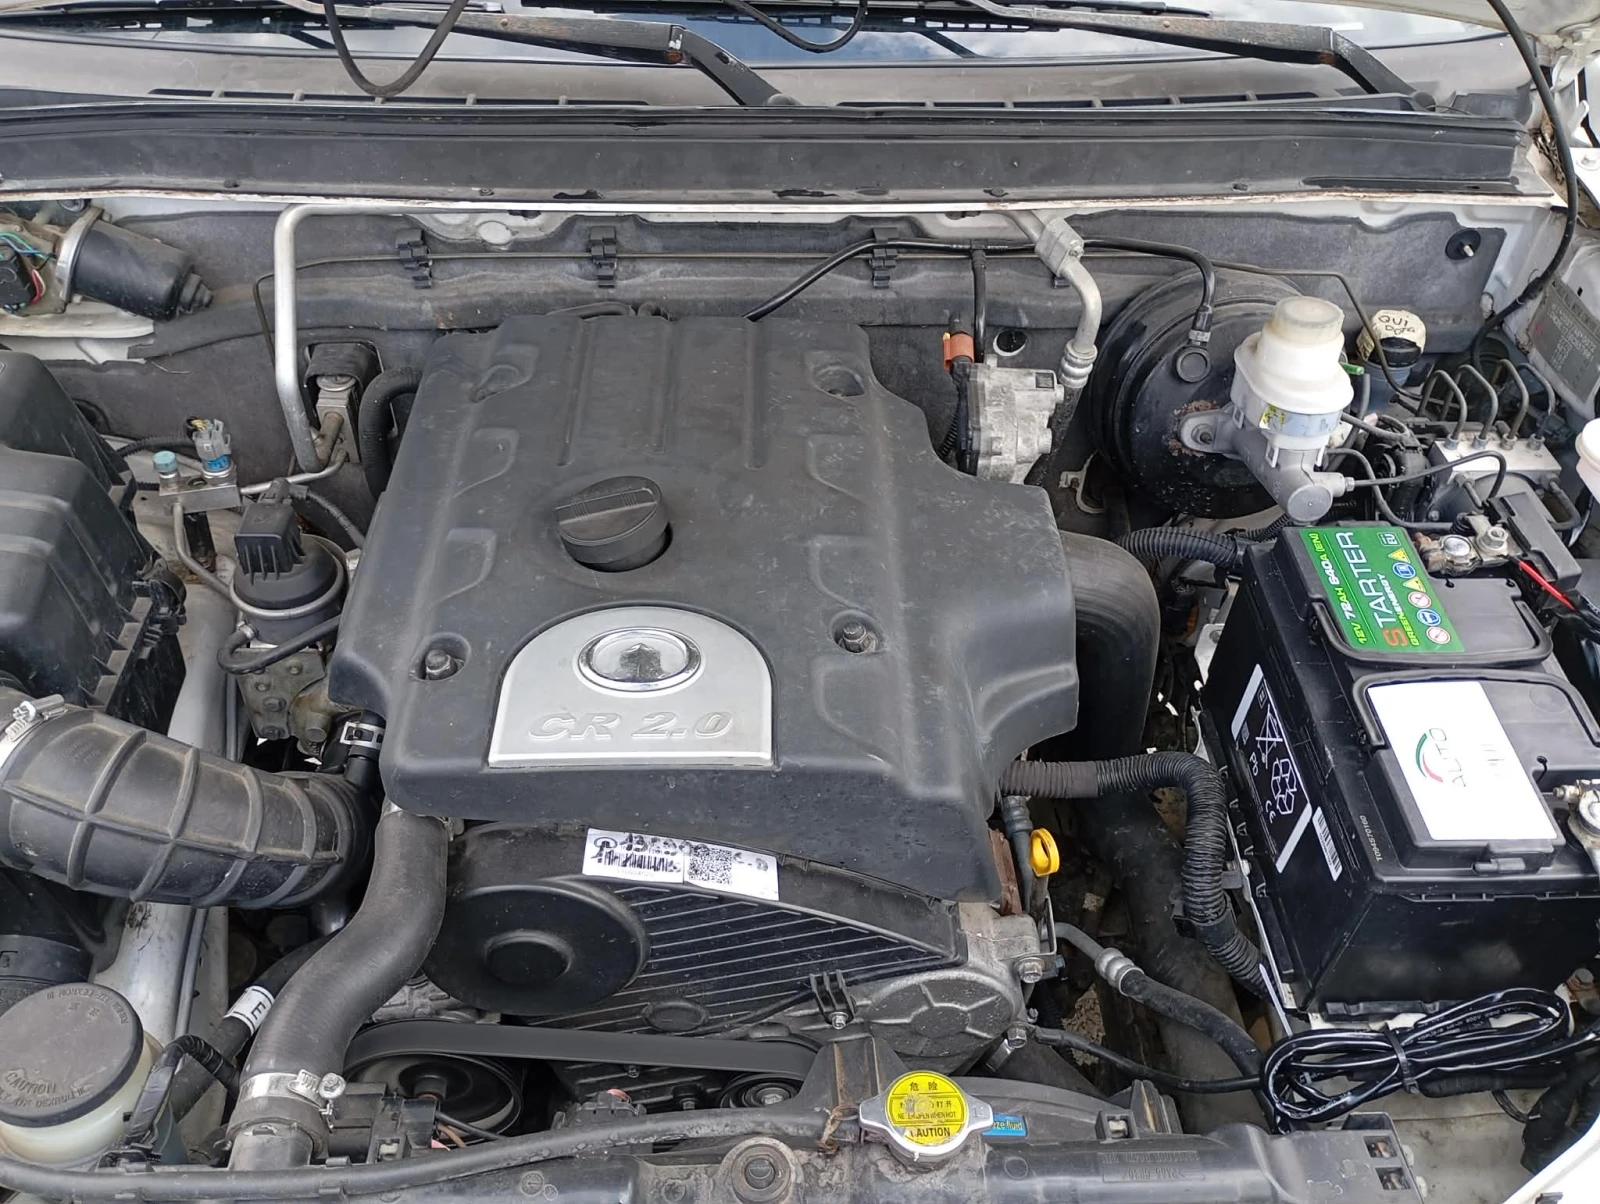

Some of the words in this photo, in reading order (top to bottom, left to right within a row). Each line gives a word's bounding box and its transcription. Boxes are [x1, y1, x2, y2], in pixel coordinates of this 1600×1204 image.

[1336, 532, 1409, 647] STARTER
[1350, 622, 1367, 644] 12V
[528, 711, 622, 740] CR
[631, 711, 734, 740] 2.0
[5, 1071, 57, 1094] CAUTION
[909, 1081, 938, 1091] 危险
